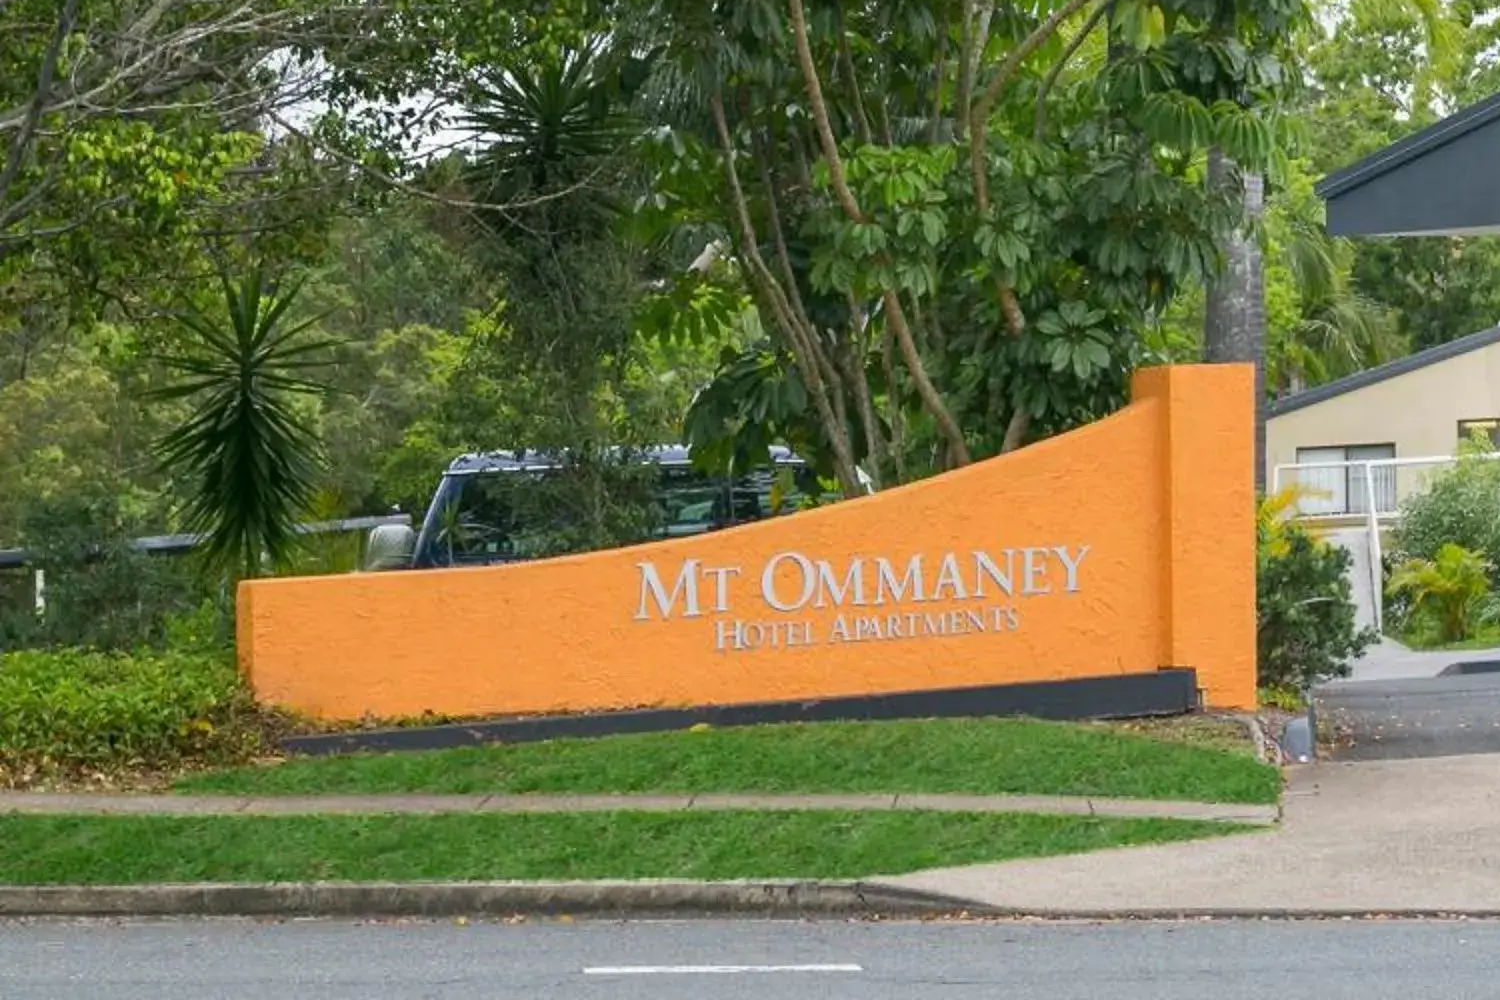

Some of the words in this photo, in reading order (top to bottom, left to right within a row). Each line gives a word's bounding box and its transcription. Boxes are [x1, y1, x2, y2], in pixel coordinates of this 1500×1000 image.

[633, 557, 741, 620] MT
[761, 544, 1092, 612] OMMANEY
[714, 618, 815, 652] HOTEL
[828, 606, 1020, 647] APARTMENTS
